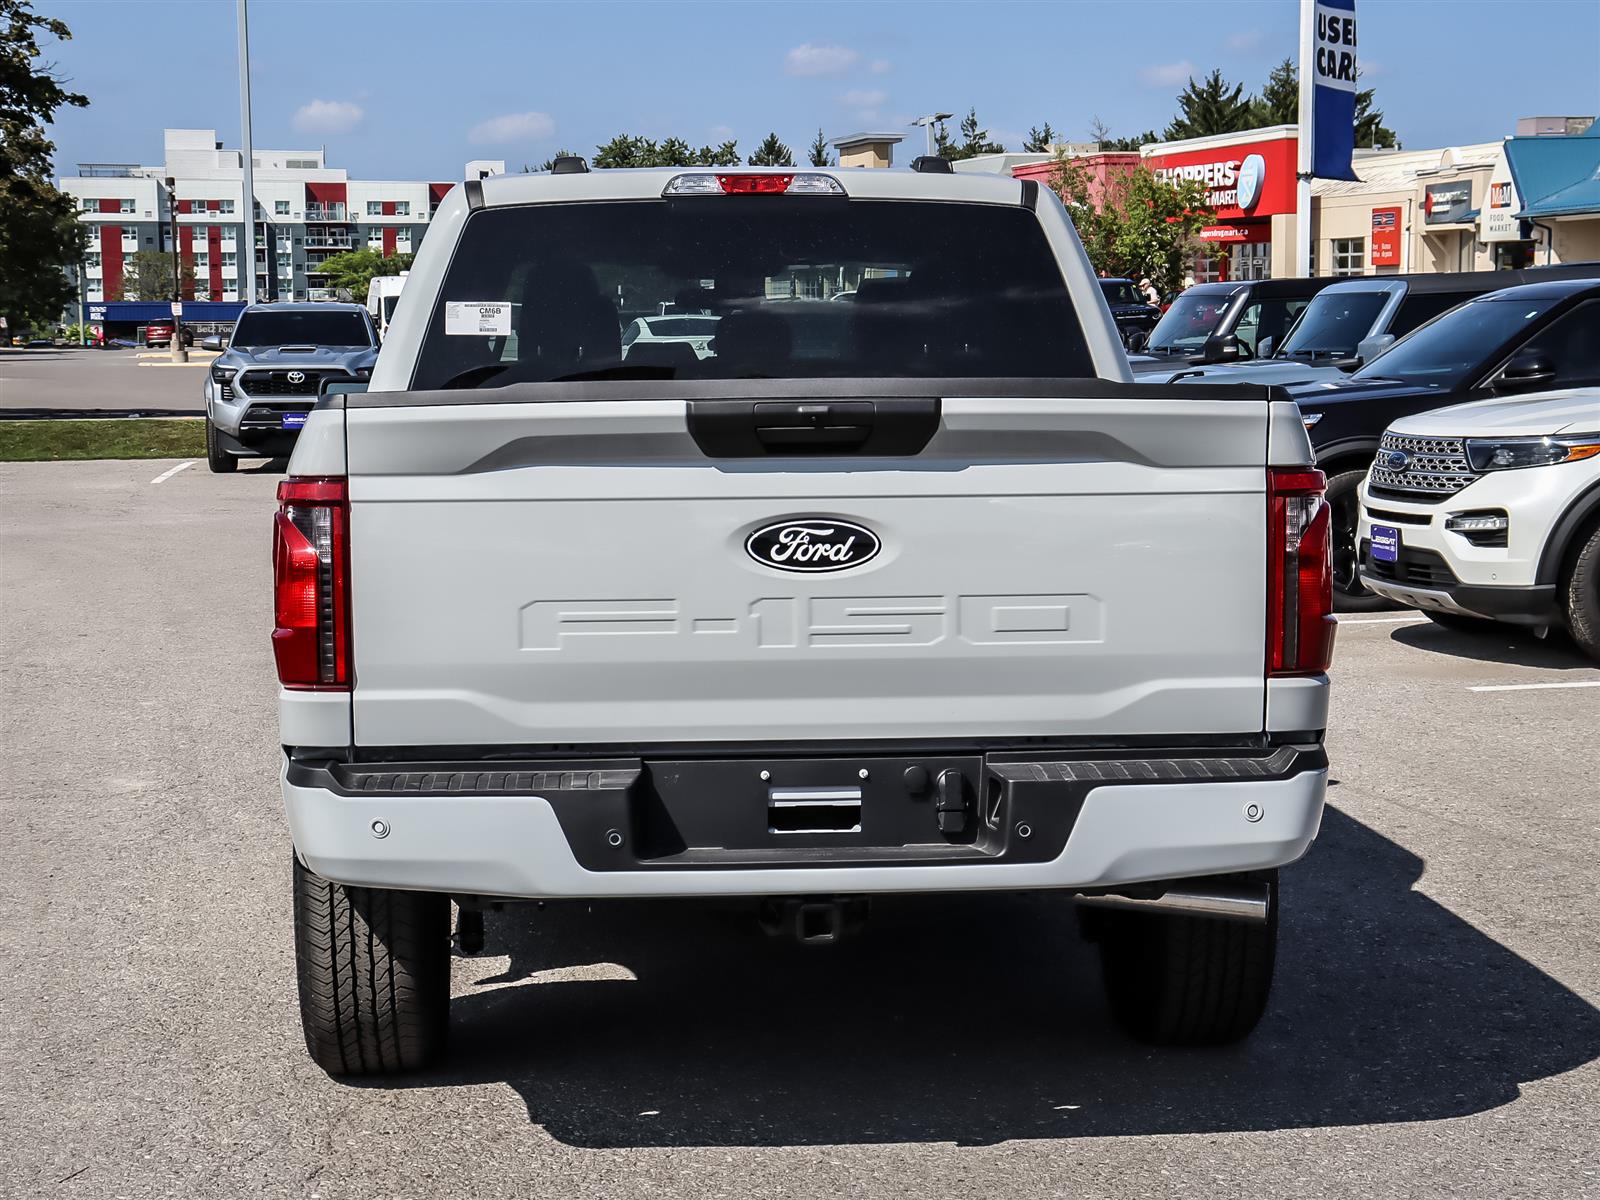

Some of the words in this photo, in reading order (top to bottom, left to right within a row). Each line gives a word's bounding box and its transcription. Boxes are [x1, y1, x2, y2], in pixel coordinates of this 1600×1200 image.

[1212, 190, 1238, 206] MART
[1491, 185, 1512, 205] M&M
[1490, 213, 1505, 222] FOOD
[1489, 223, 1512, 233] MARKET
[479, 307, 502, 315] CM6B
[770, 526, 856, 562] Ford
[518, 593, 1107, 651] F-150
